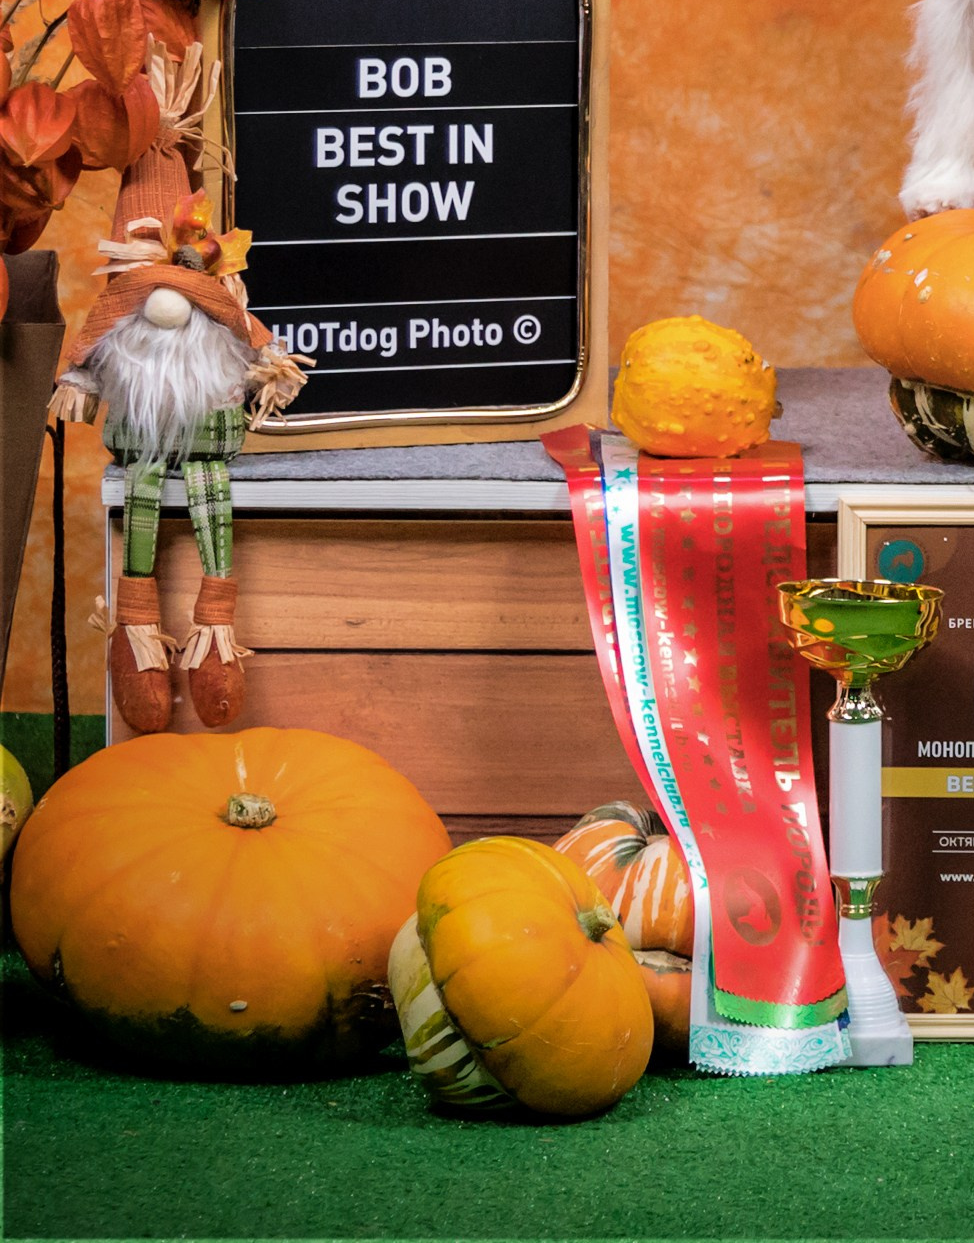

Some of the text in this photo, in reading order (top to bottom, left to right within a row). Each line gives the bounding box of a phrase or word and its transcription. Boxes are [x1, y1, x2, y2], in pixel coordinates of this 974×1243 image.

[358, 57, 451, 98] BOB
[317, 124, 493, 167] BEST IN
[336, 181, 475, 224] SHOW
[272, 320, 397, 358] HOTdog
[410, 318, 502, 348] Photo
[620, 523, 691, 828] www.moscow-kennelclub.ru
[762, 475, 826, 947] ПРЕДСАВИТЕЛЬ ПОРОДЫ
[718, 665, 757, 814] ВЫСТАВКА
